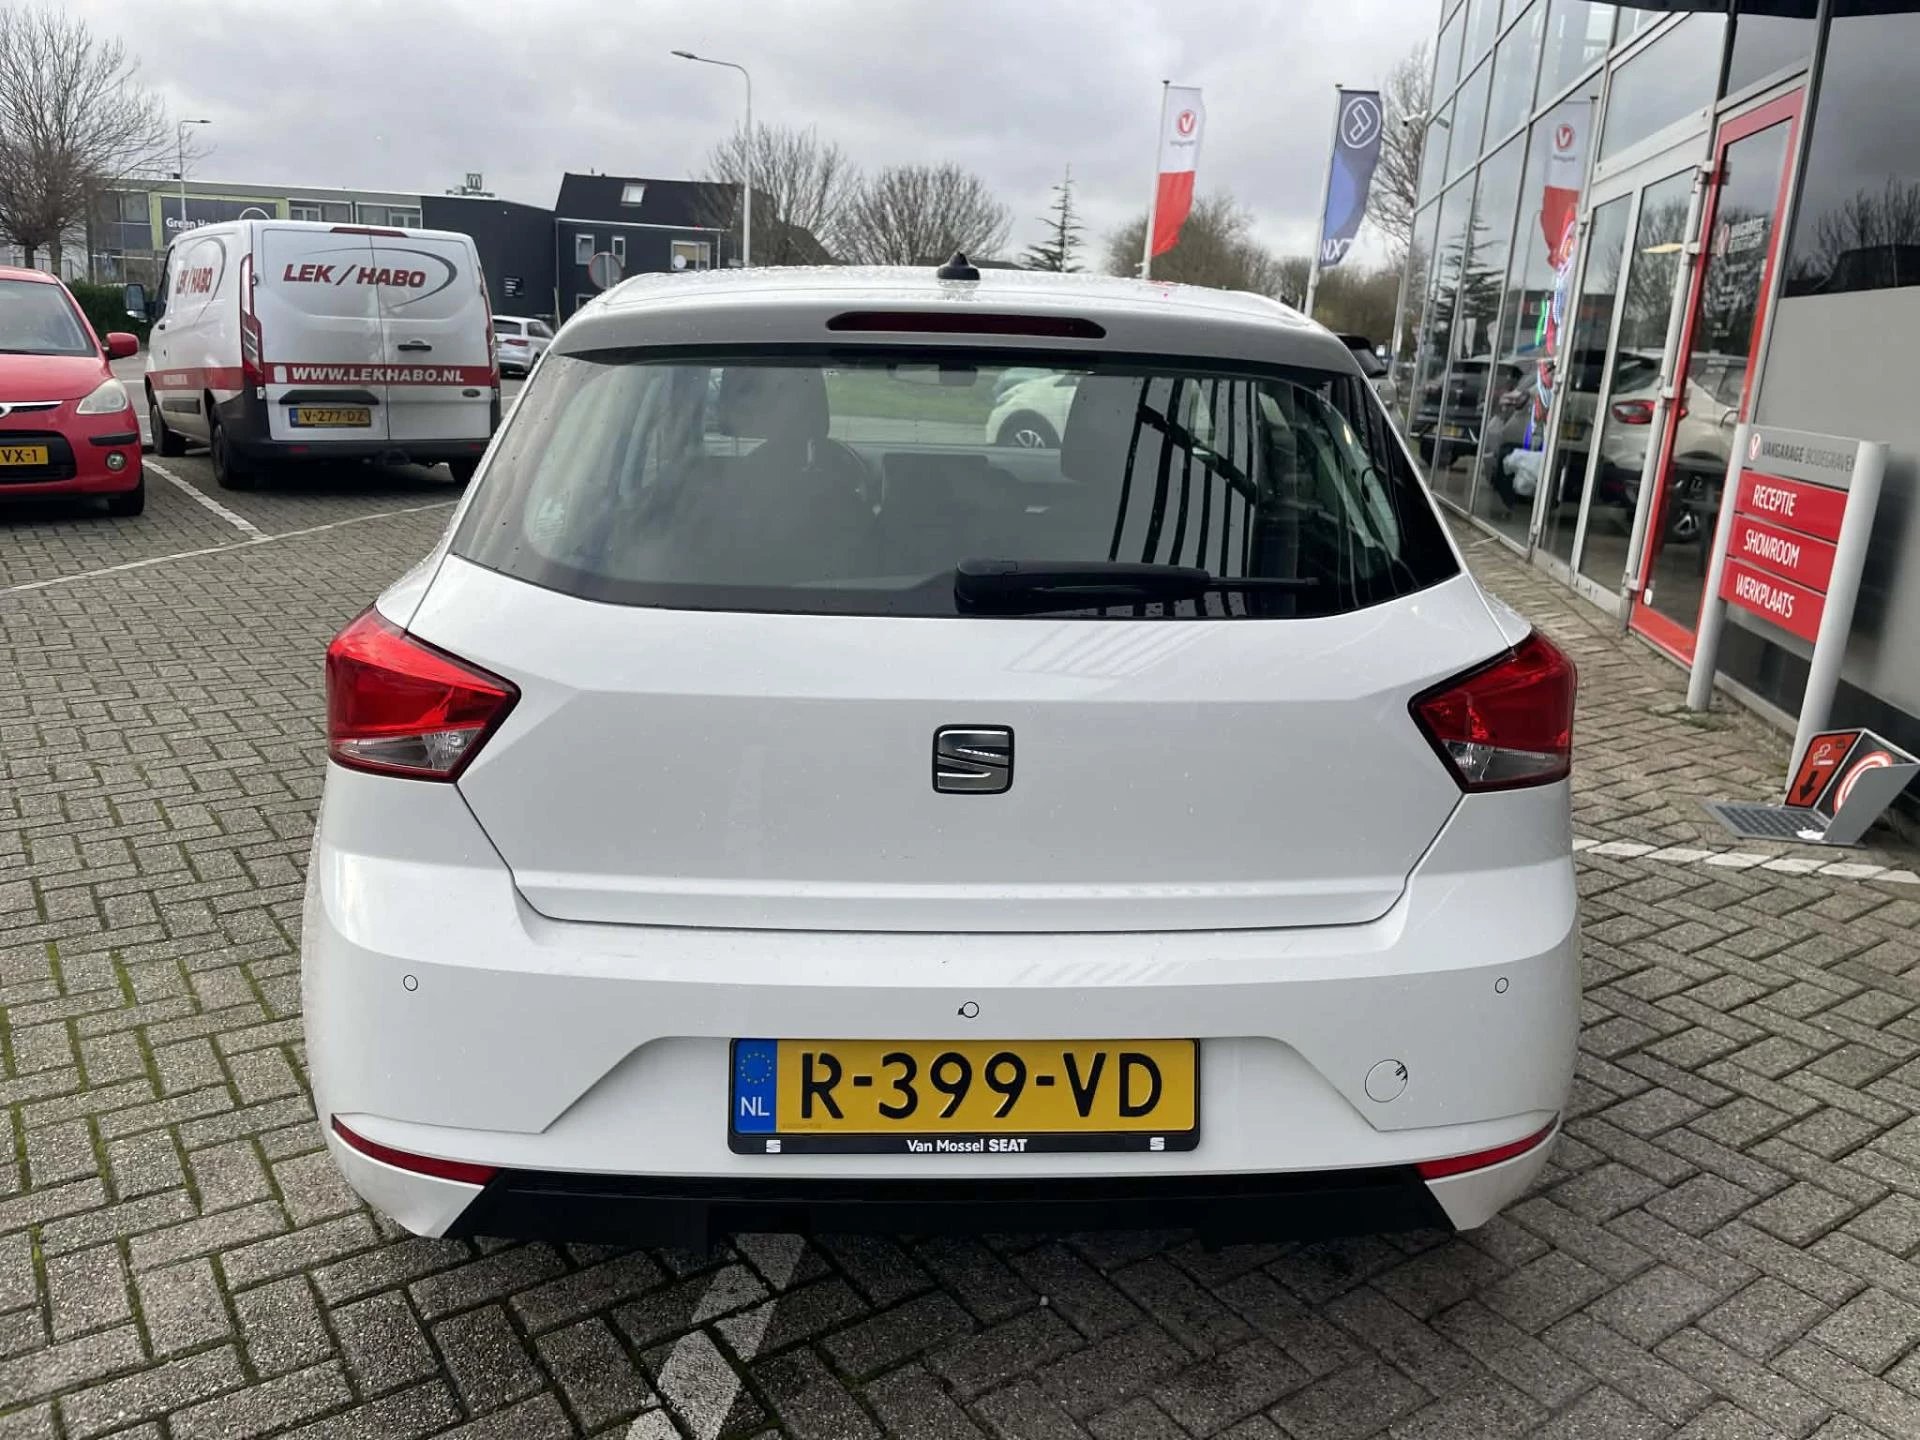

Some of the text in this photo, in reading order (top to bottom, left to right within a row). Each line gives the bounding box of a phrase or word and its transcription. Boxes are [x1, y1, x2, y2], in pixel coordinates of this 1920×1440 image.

[292, 367, 464, 383] WWW.LEKHABO.NL
[1752, 484, 1797, 516] RECEPTIE
[1744, 529, 1800, 568] SHOWROOM
[1735, 573, 1795, 618] WERKPLAATS
[801, 1051, 1163, 1119] R-399-VD
[740, 1096, 770, 1116] NL
[906, 1138, 1028, 1152] Van Mossel SEAT
